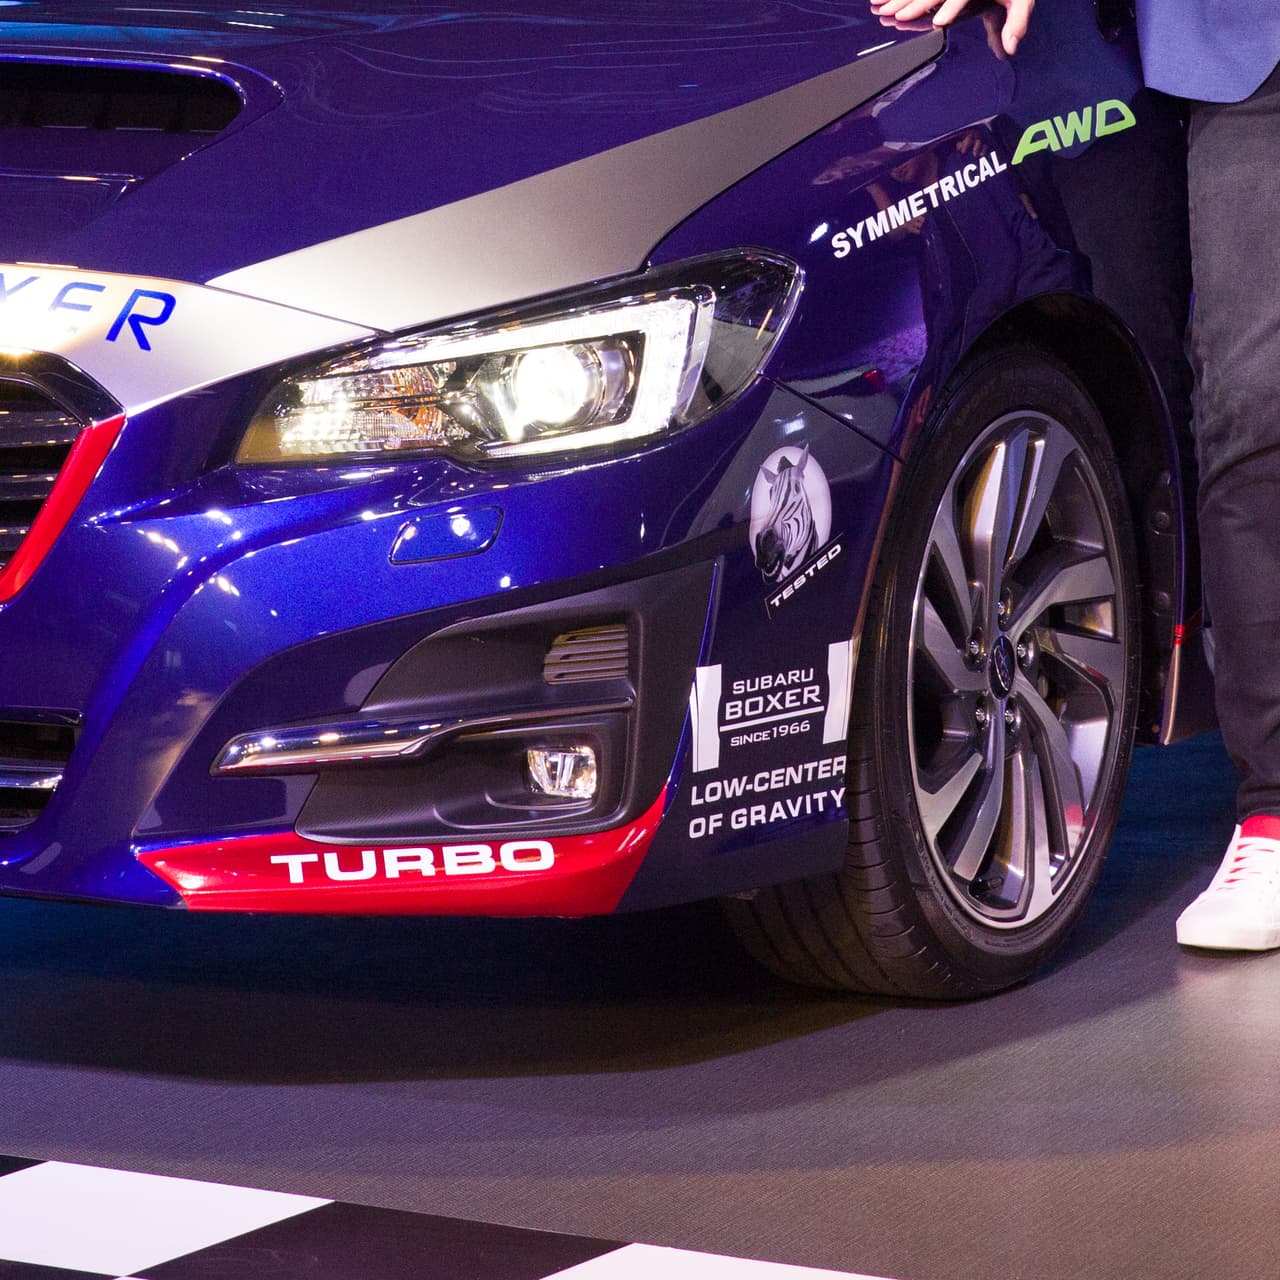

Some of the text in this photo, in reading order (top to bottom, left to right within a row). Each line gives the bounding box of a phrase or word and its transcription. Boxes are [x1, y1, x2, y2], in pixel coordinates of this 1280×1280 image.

[831, 98, 1136, 258] SYMMETRICAL AWD
[770, 544, 842, 607] TESTED
[725, 685, 822, 720] BOXER
[732, 668, 814, 695] SUBARU
[691, 755, 847, 806] LOW-CENTER
[689, 787, 846, 839] OF GRAVITY
[270, 839, 555, 884] TURBO
